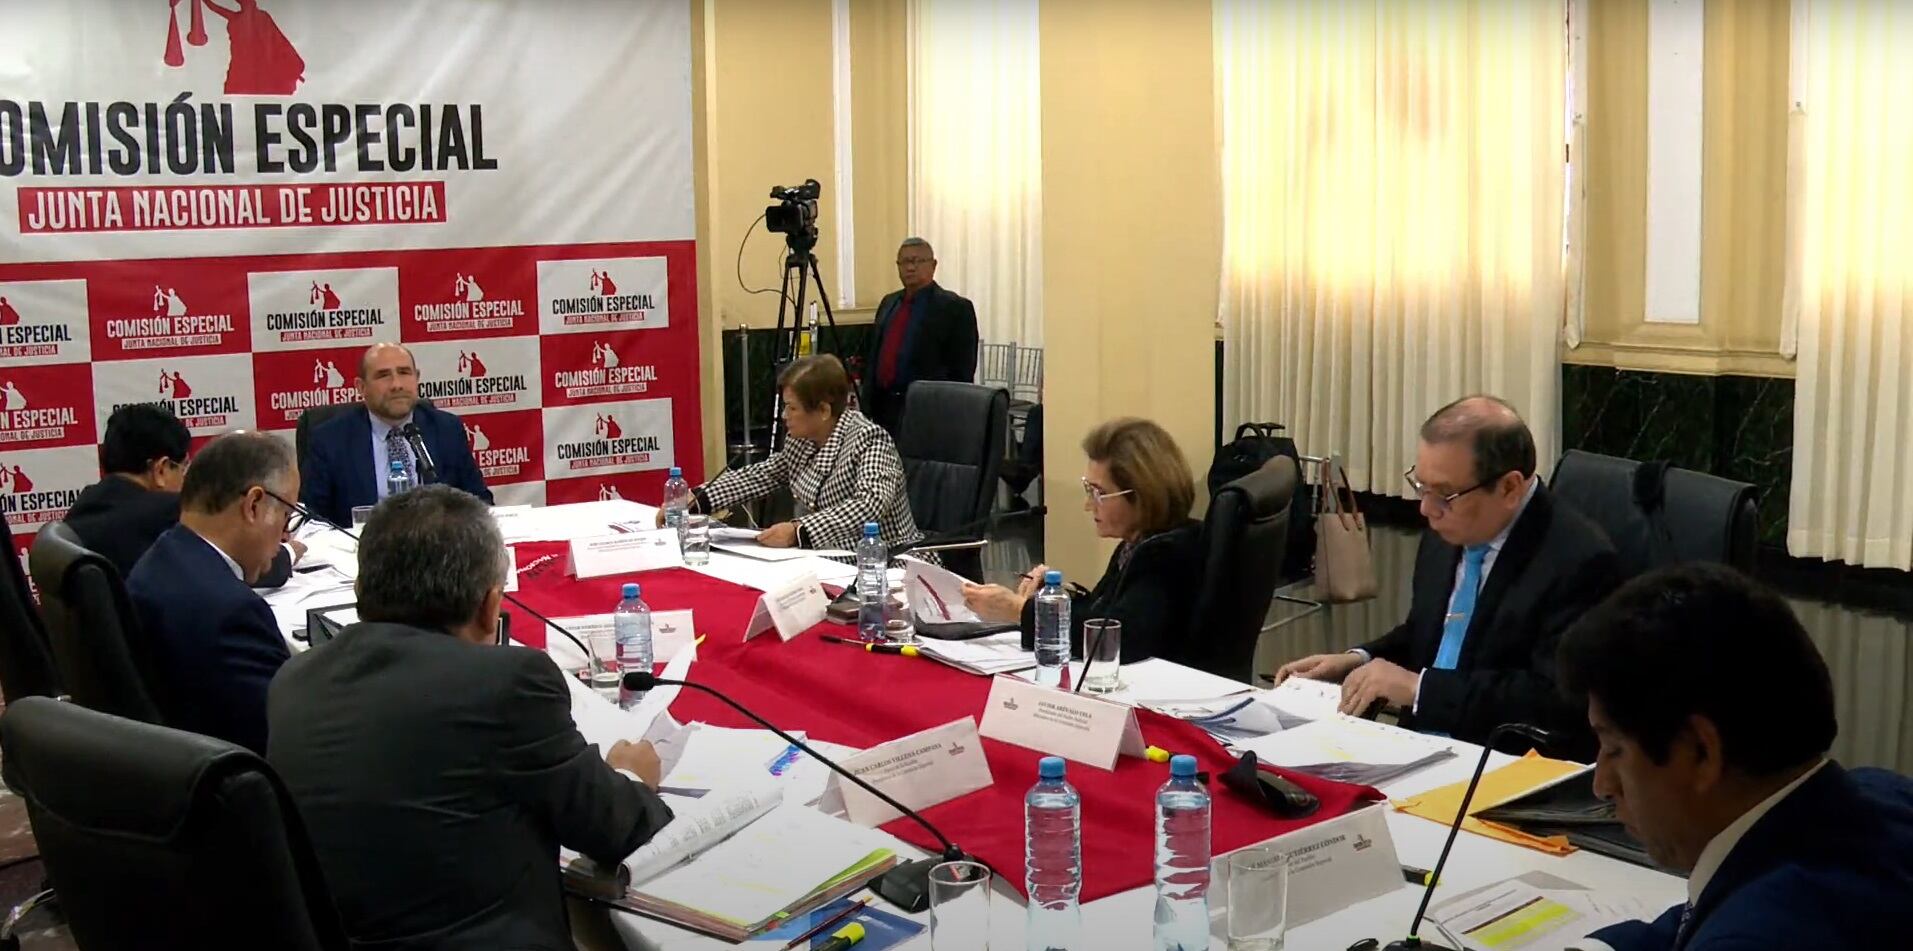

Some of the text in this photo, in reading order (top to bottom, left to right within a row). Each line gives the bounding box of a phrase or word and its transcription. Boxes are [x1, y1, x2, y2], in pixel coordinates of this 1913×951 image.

[254, 103, 498, 173] ESPECIAL
[28, 185, 438, 230] JUNTA NACIONAL DE JUSTICIA
[414, 300, 524, 321] COMISIÓN ESPECIAL
[552, 294, 655, 314] COMISIÓN ESPECIAL
[107, 315, 234, 338] COMISIÓN ESPECIAL
[267, 308, 384, 330] COMISIÓN ESPECIAL
[7, 324, 72, 344] ESPECIAL
[123, 339, 146, 348] JUNTA
[190, 335, 220, 344] JUSTICIA
[24, 344, 56, 355] JUSTICIA
[417, 375, 527, 398] COMISIÓN ESPECIAL
[555, 365, 657, 388] COMISIÓN ESPECIAL
[180, 396, 239, 416] ESPECIAL
[271, 387, 330, 410] COMISIÓN
[13, 407, 78, 429] ESPECIAL
[195, 415, 225, 427] JUSTICIA
[31, 428, 62, 439] JUSTICIA
[479, 446, 530, 467] ESPECIAL
[557, 436, 660, 459] COMISIÓN ESPECIAL
